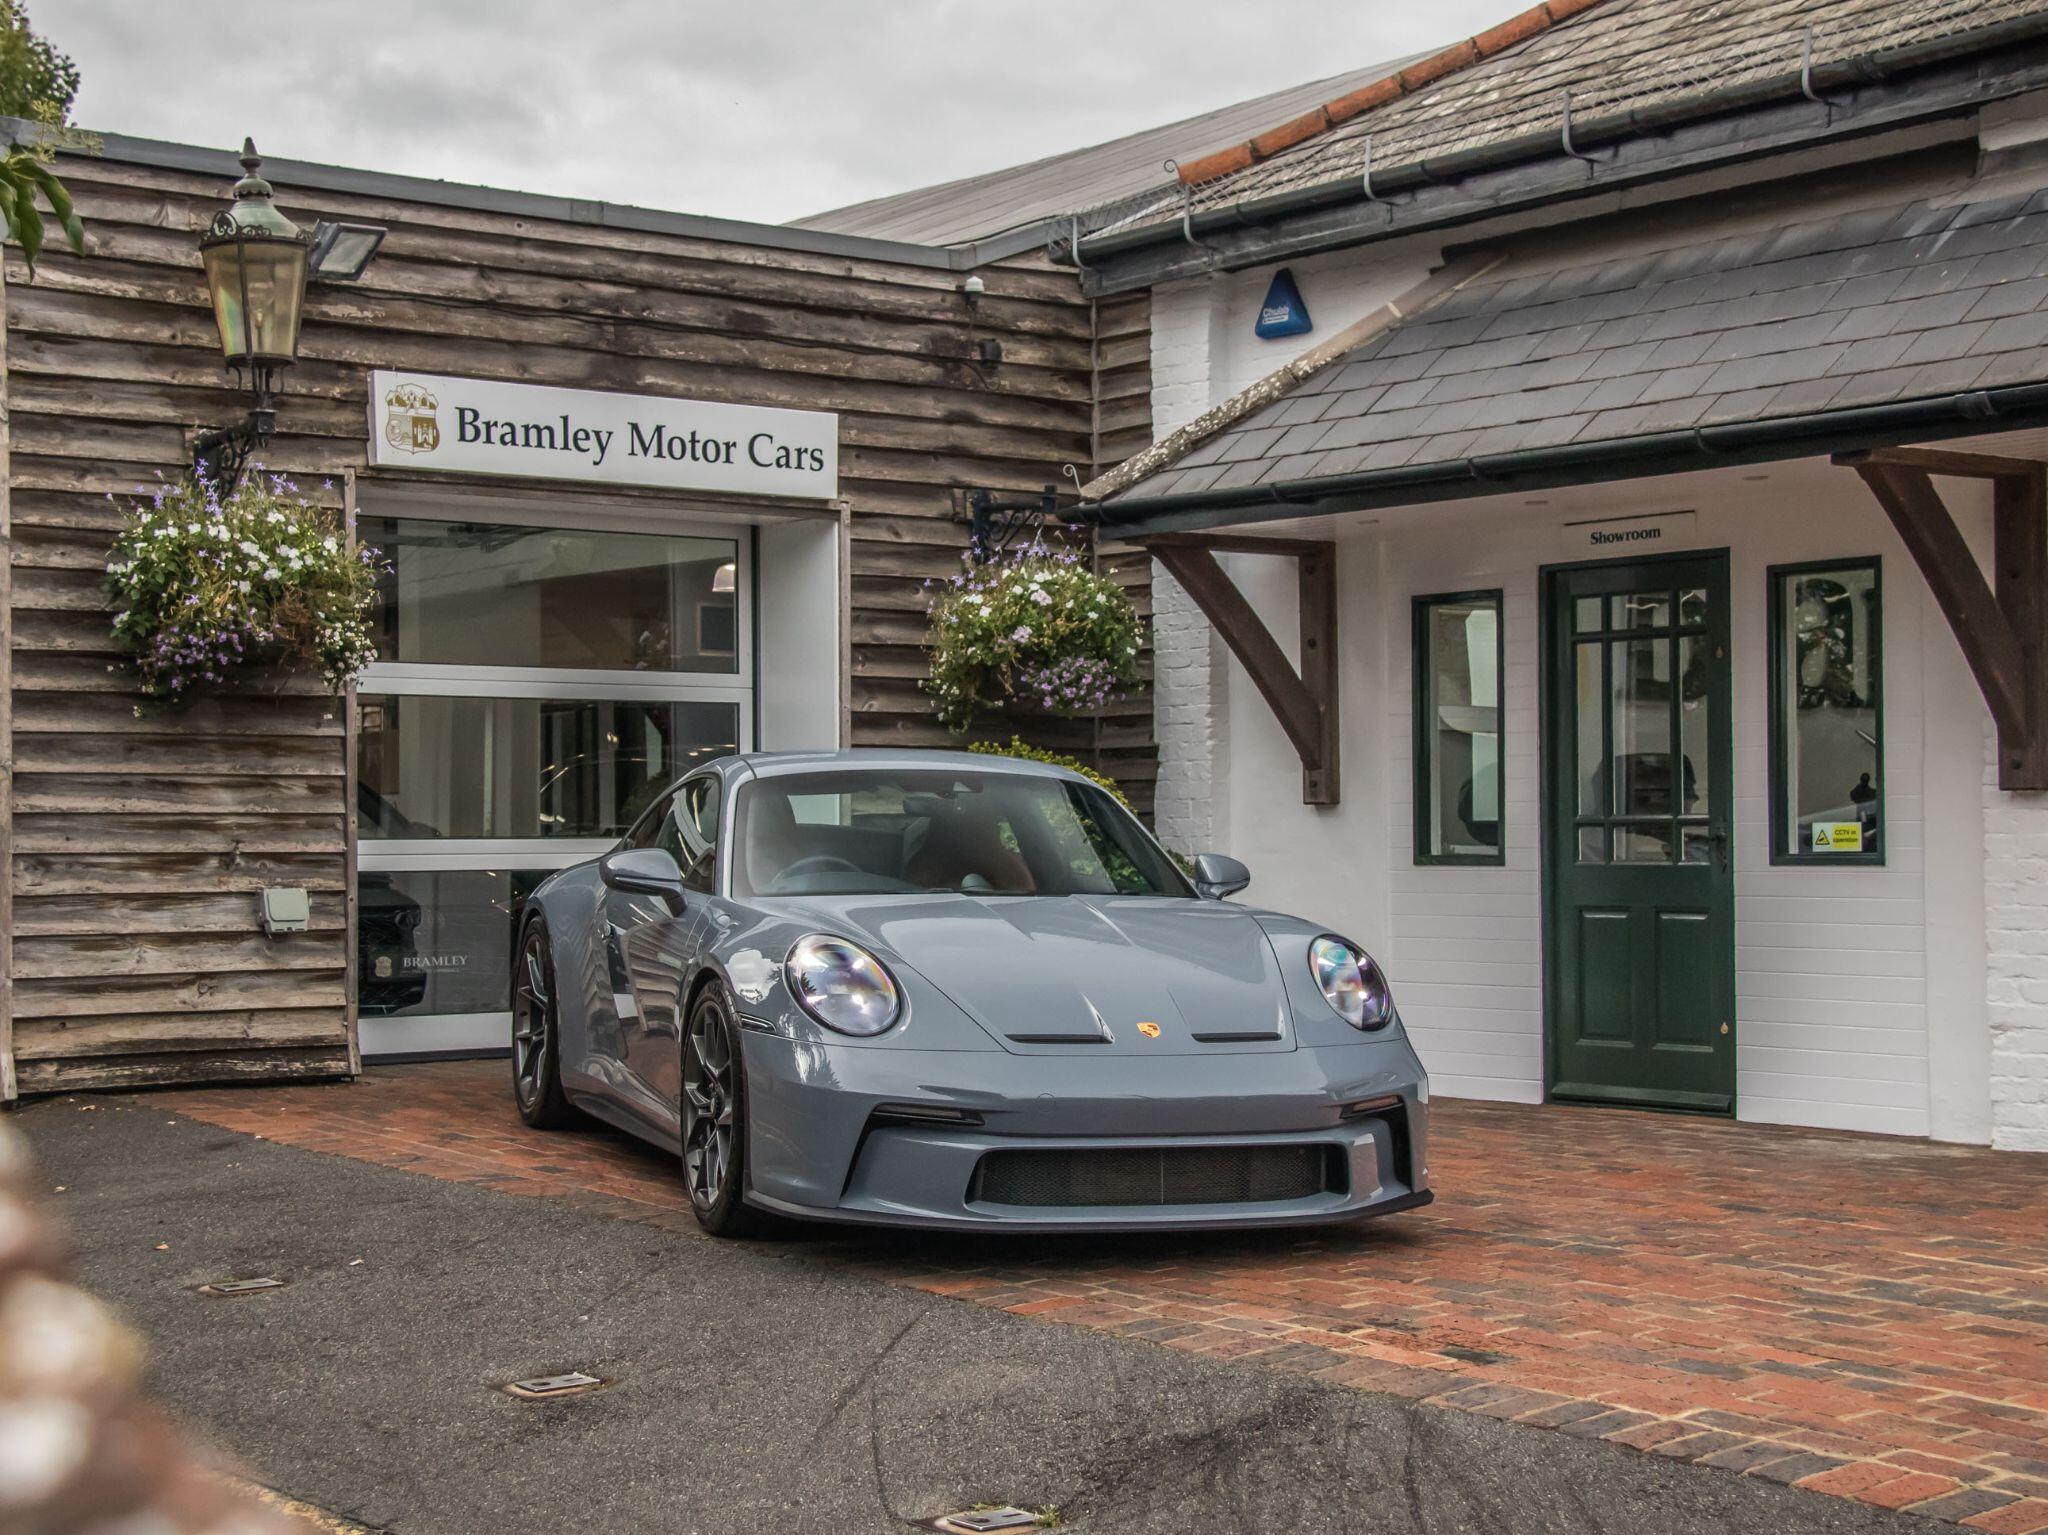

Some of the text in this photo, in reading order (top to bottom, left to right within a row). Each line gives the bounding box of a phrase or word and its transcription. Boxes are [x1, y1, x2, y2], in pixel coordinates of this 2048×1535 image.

[454, 406, 825, 472] Bramley Motor Cars
[1590, 527, 1661, 545] Showroom
[403, 954, 468, 968] BRAMLEY
